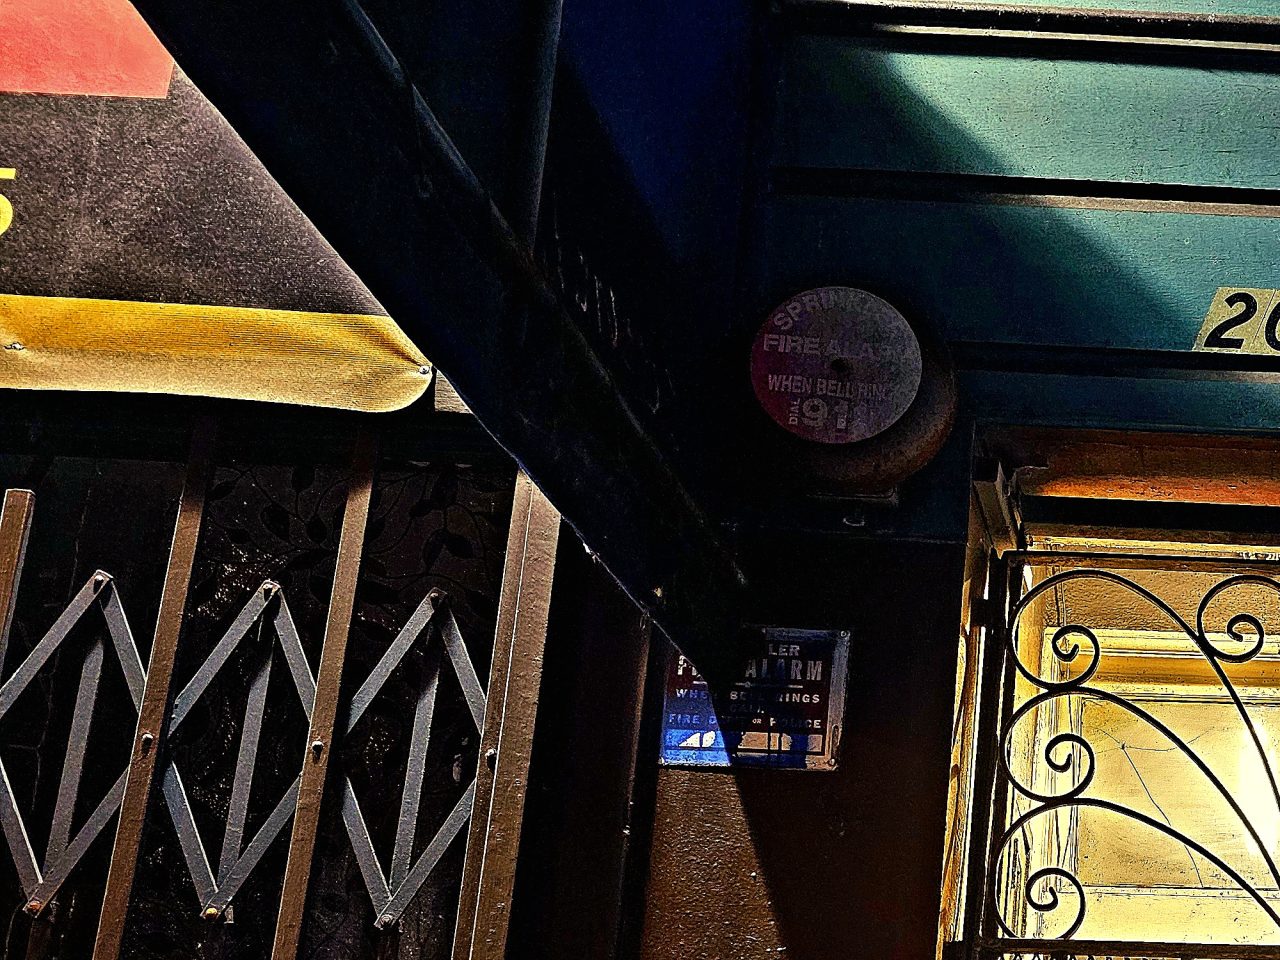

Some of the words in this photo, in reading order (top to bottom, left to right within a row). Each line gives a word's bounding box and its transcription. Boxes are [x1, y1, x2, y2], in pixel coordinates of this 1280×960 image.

[763, 333, 821, 355] FIRE
[767, 374, 814, 395] WHEN
[816, 378, 853, 399] BELL
[668, 713, 700, 725] FIRE
